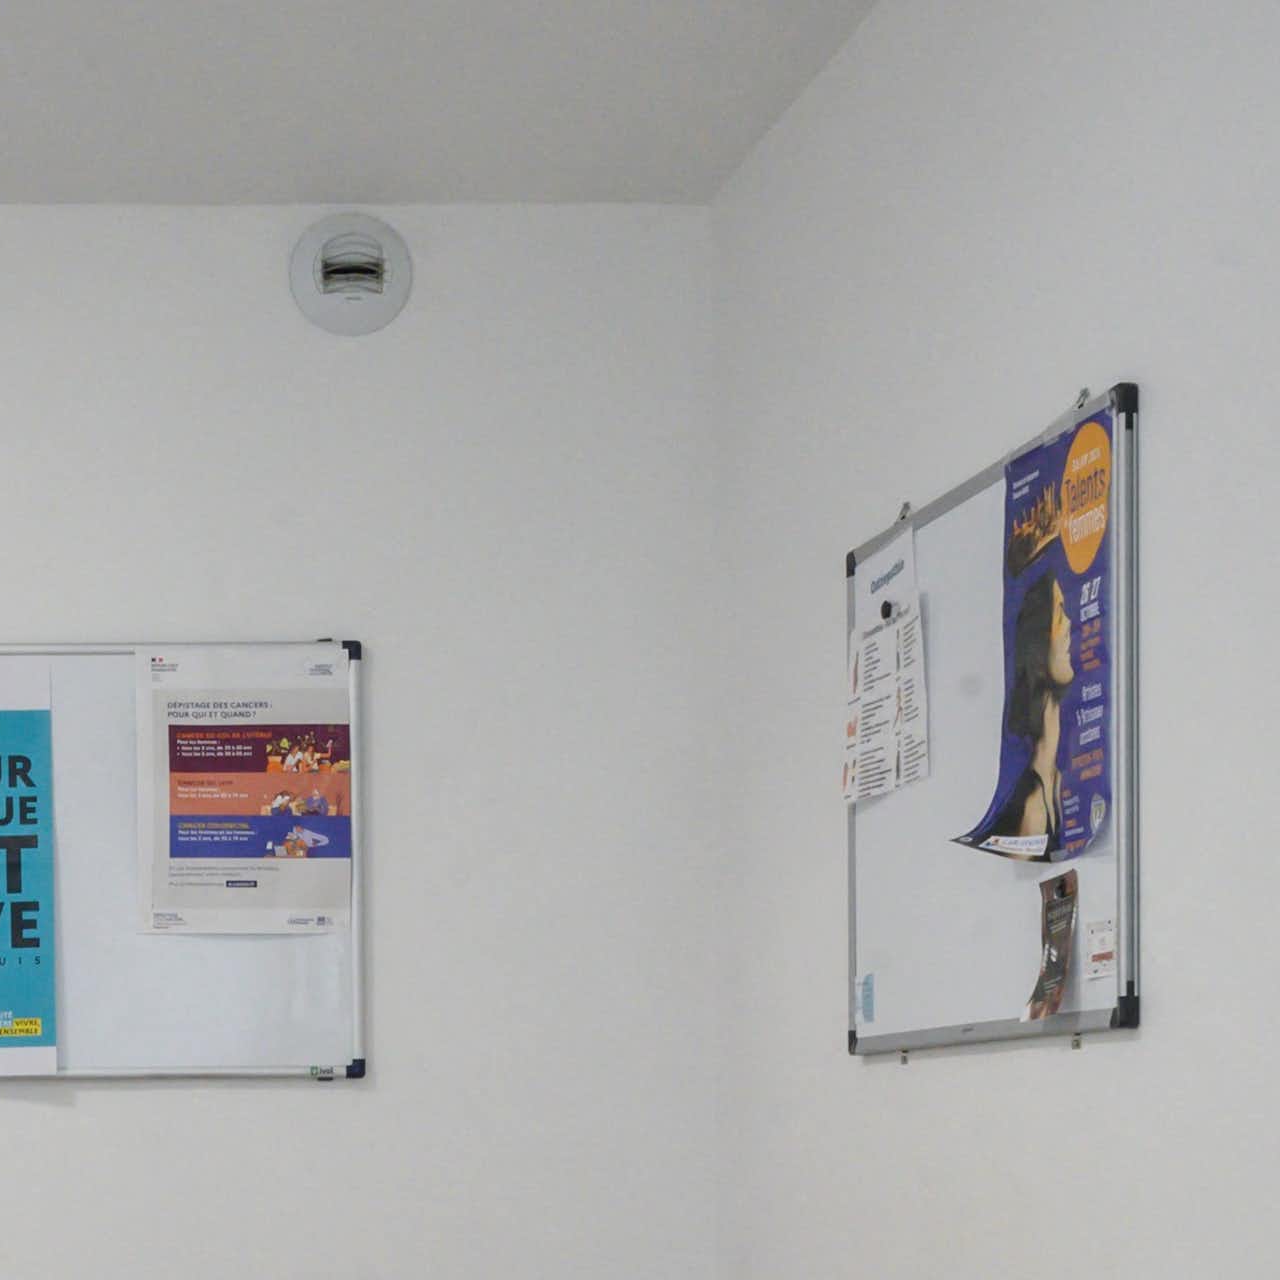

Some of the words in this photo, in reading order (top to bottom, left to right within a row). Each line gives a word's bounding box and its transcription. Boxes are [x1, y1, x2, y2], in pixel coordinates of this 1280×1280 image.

[1065, 468, 1106, 513] Talents
[167, 701, 211, 709] DÉPISTAGE
[191, 711, 206, 719] QUI
